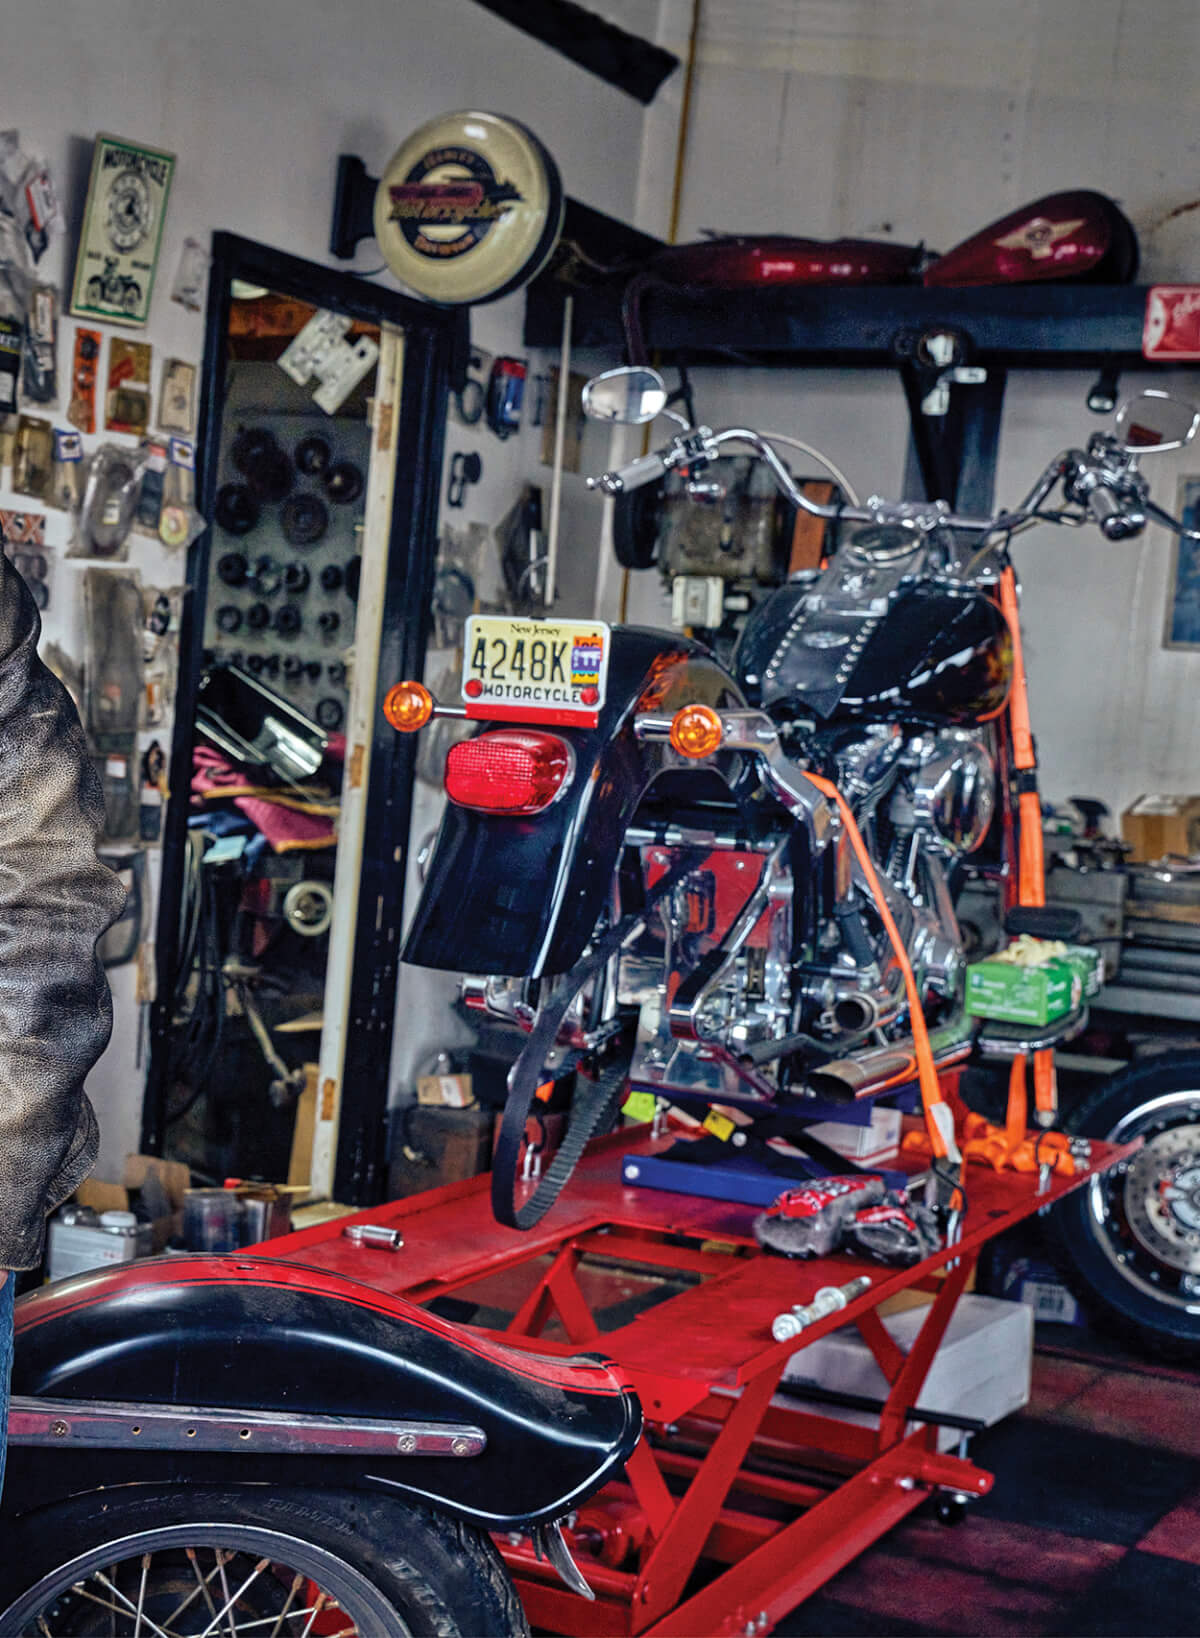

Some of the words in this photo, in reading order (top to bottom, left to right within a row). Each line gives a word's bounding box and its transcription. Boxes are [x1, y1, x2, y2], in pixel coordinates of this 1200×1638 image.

[510, 623, 532, 634] New
[533, 624, 560, 636] Jersey
[471, 637, 568, 683] 4248K
[483, 684, 580, 703] MOTORCYCLE
